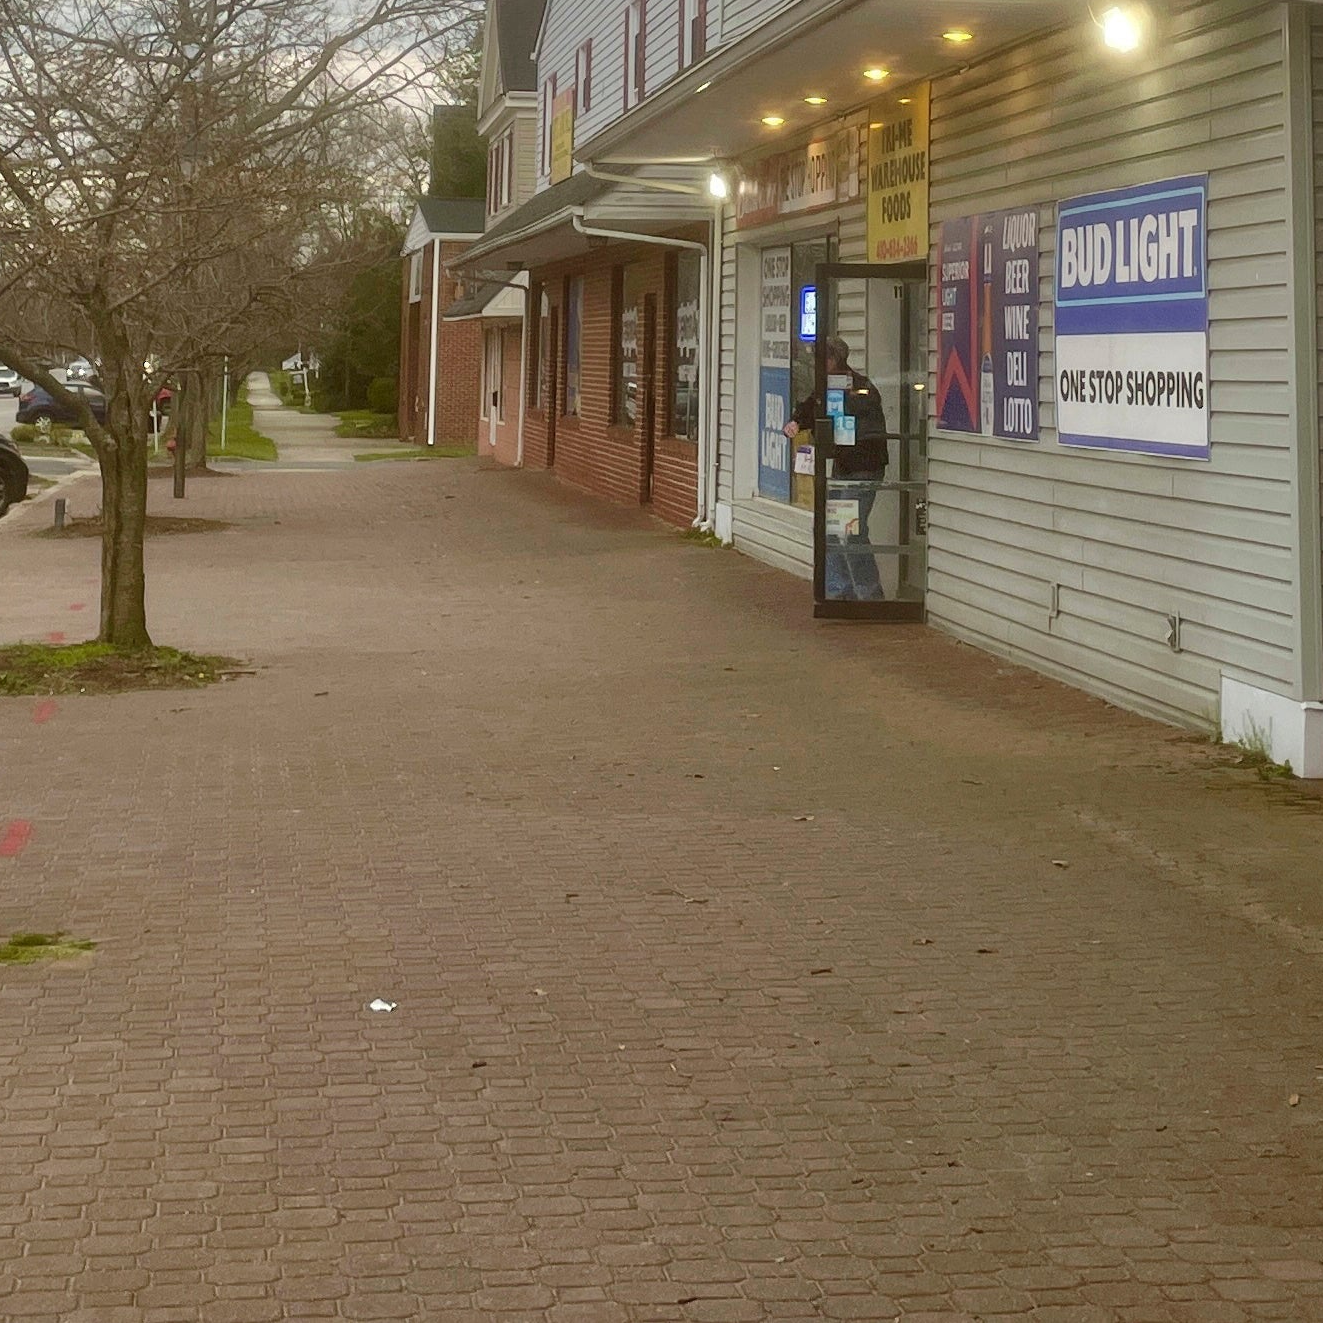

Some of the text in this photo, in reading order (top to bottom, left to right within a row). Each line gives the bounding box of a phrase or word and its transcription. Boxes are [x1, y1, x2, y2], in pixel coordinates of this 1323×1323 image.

[882, 118, 913, 154] TRI-ME
[871, 151, 925, 192] WAREHOUSE
[881, 190, 912, 224] FOODS
[1002, 212, 1036, 252] LIQUOR
[1061, 209, 1198, 288] BUD LIGHT
[941, 260, 970, 281] SUPERIOR
[1005, 259, 1030, 294] BEER
[1004, 304, 1031, 339] WINE
[1006, 351, 1027, 386] DELI
[1060, 369, 1205, 409] ONE STOP SHOPPING
[1003, 397, 1033, 434] LOTTO
